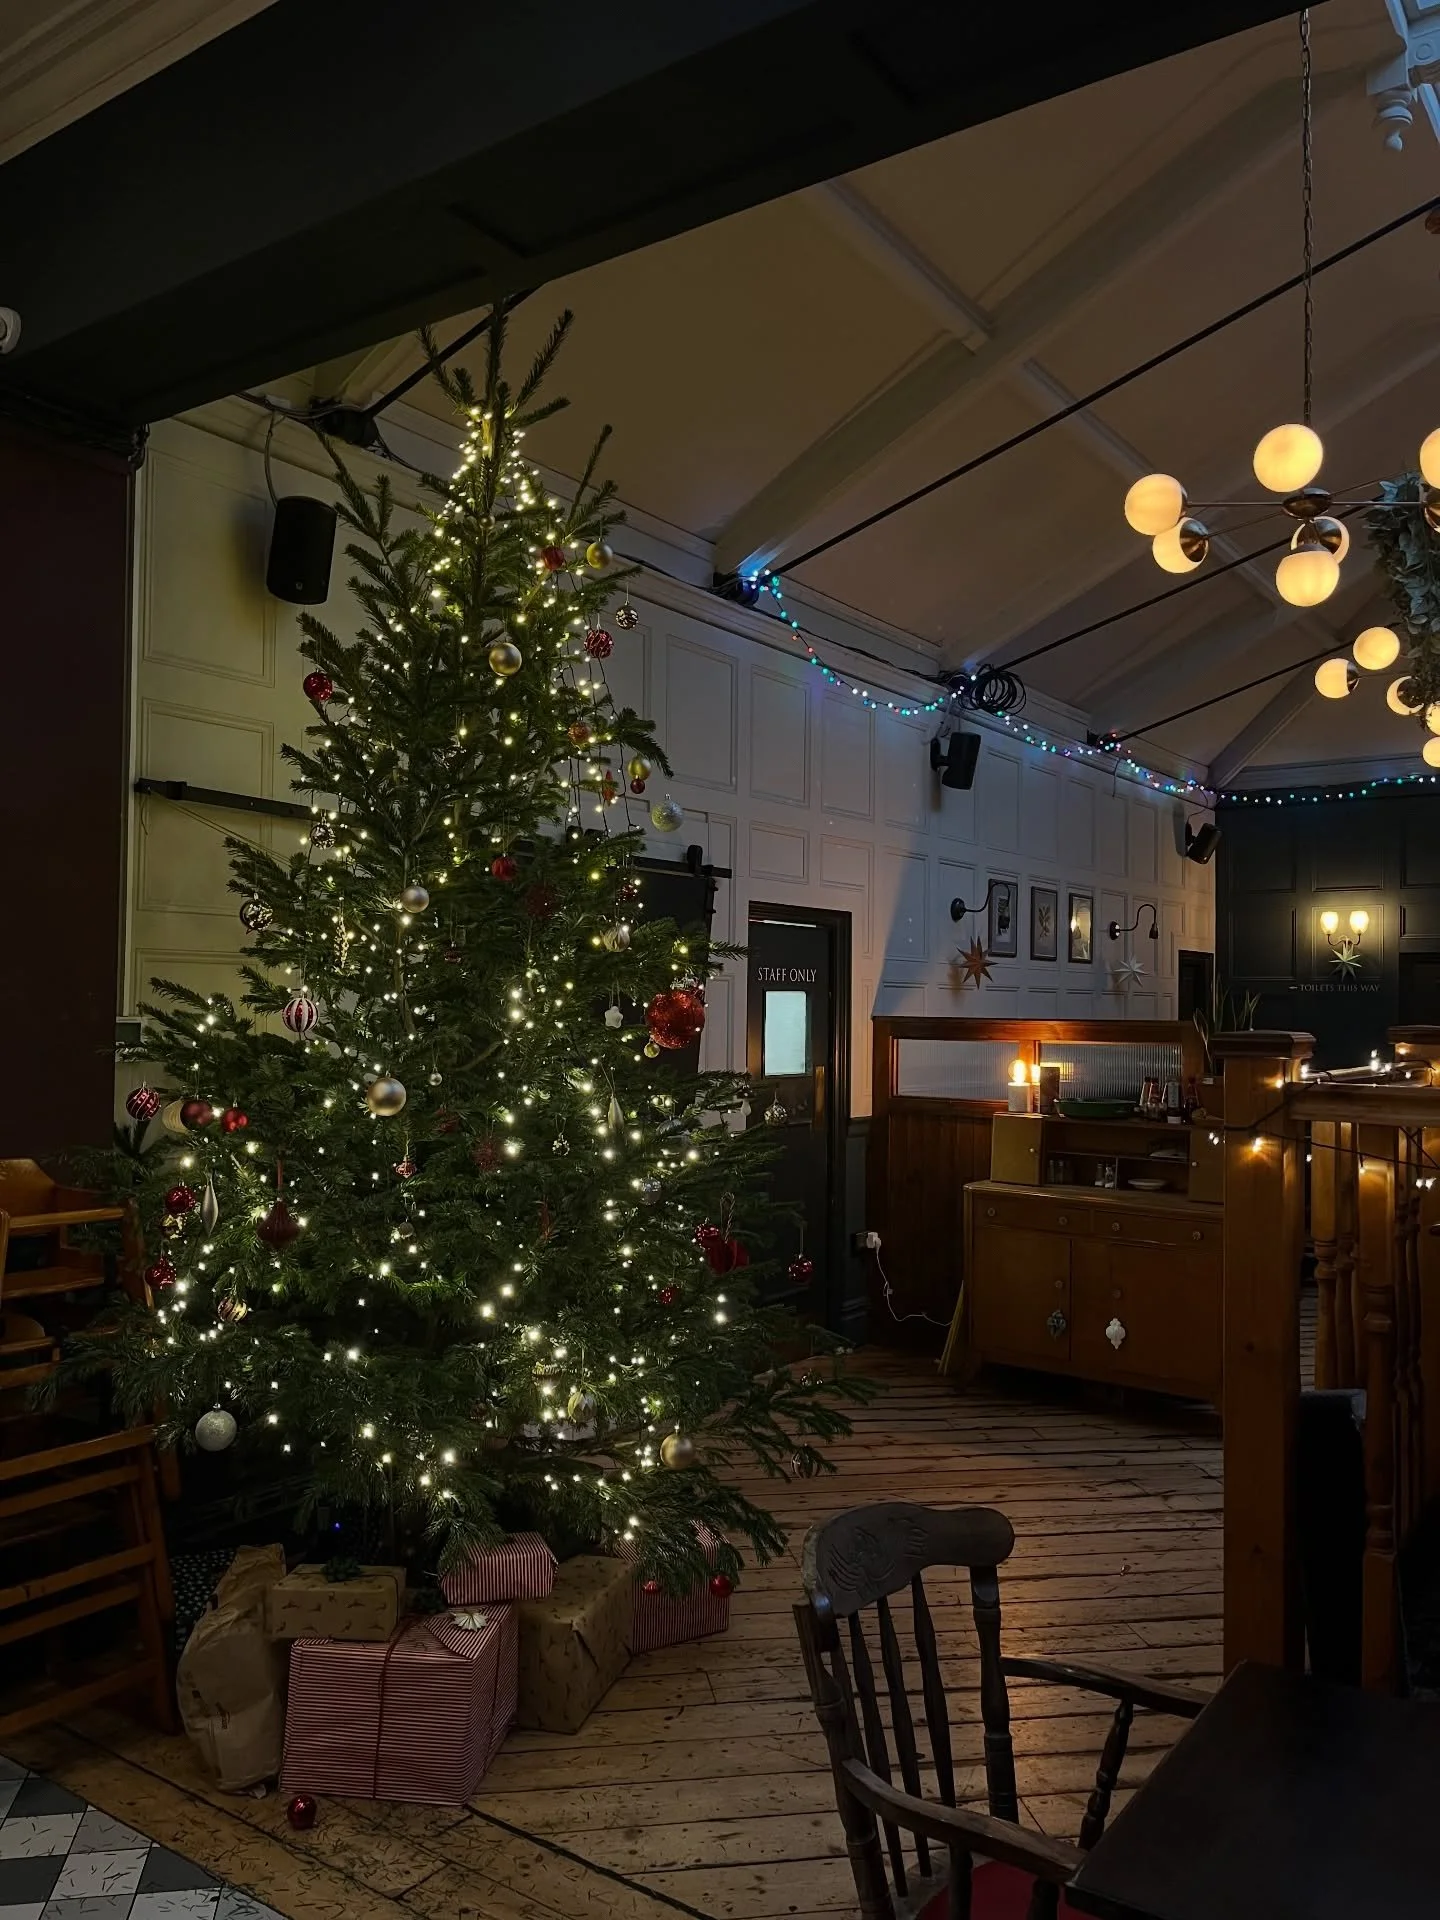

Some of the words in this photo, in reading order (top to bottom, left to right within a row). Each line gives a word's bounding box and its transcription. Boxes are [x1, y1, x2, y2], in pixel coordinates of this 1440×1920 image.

[758, 967, 787, 981] STAFF
[790, 968, 817, 982] ONLY
[1300, 984, 1334, 992] TOILETS
[1338, 984, 1359, 992] THIS
[1360, 984, 1380, 992] WAY
